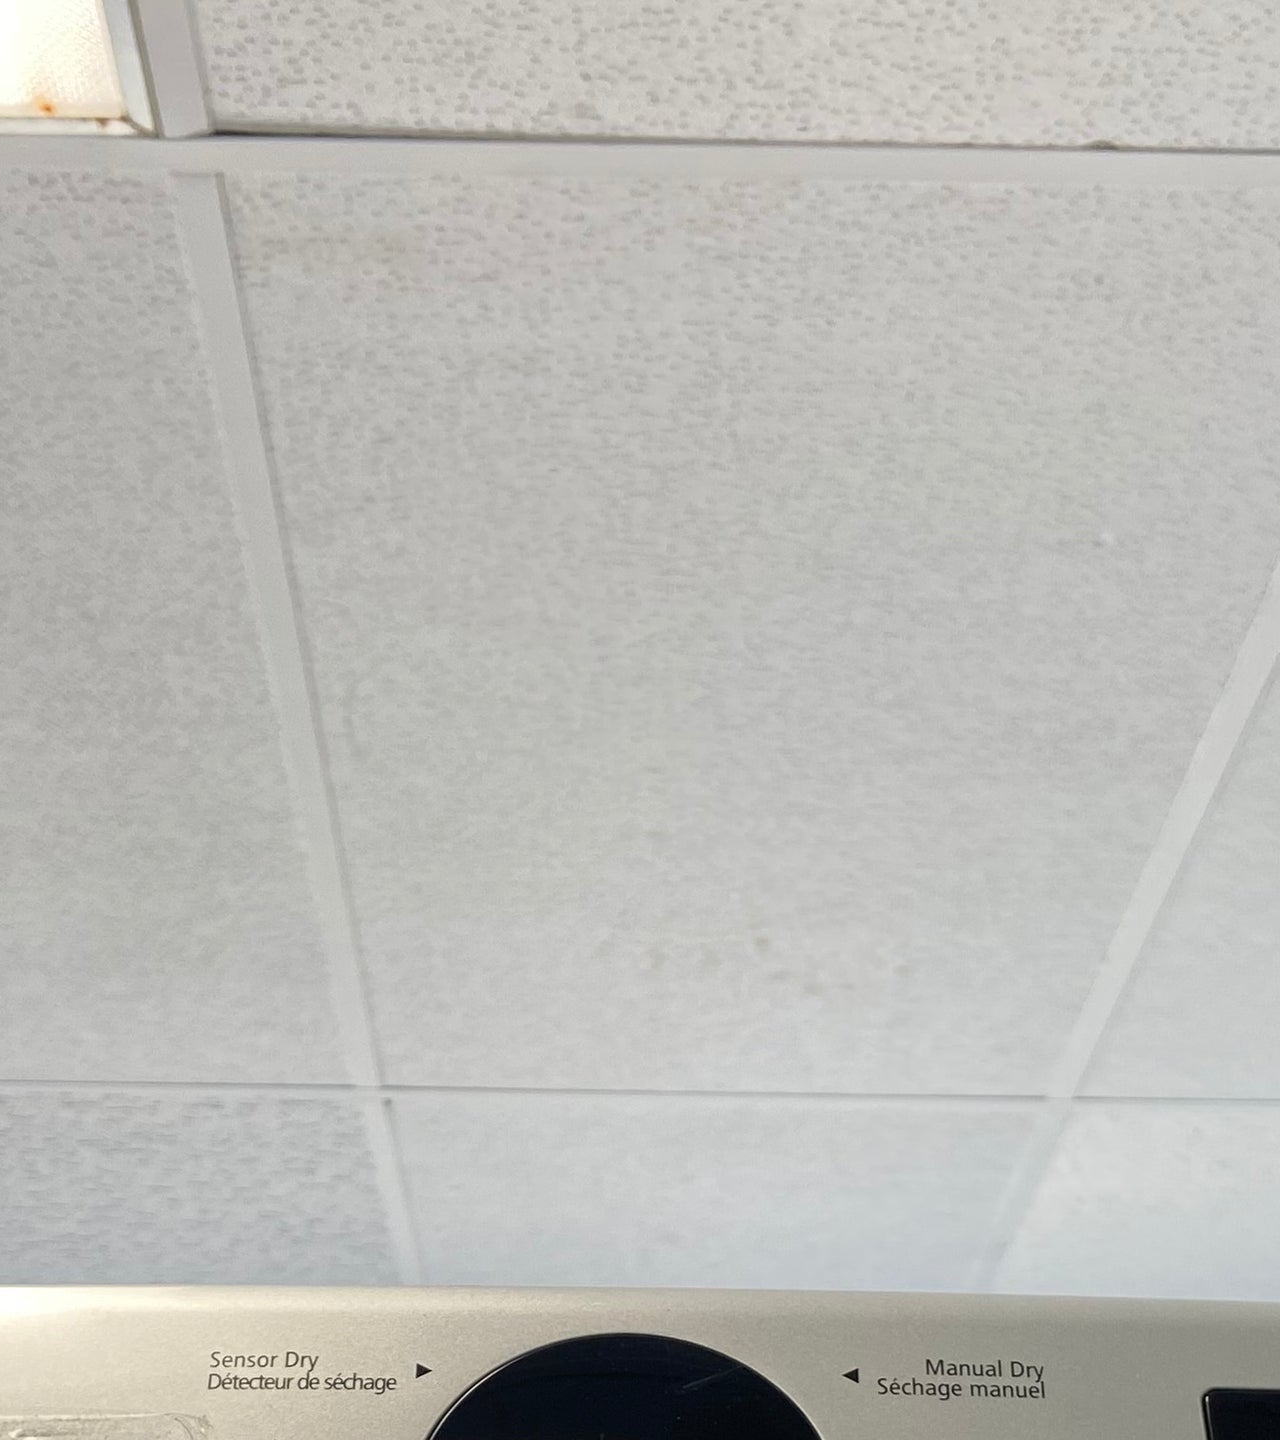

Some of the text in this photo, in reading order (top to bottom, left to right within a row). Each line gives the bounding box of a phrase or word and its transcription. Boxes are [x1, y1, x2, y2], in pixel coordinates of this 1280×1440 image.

[210, 1351, 319, 1373] Sensor Dry
[925, 1359, 1044, 1382] Manual Dry
[207, 1373, 397, 1395] Détecteur de séchage
[877, 1378, 1045, 1400] Séchage manuel
